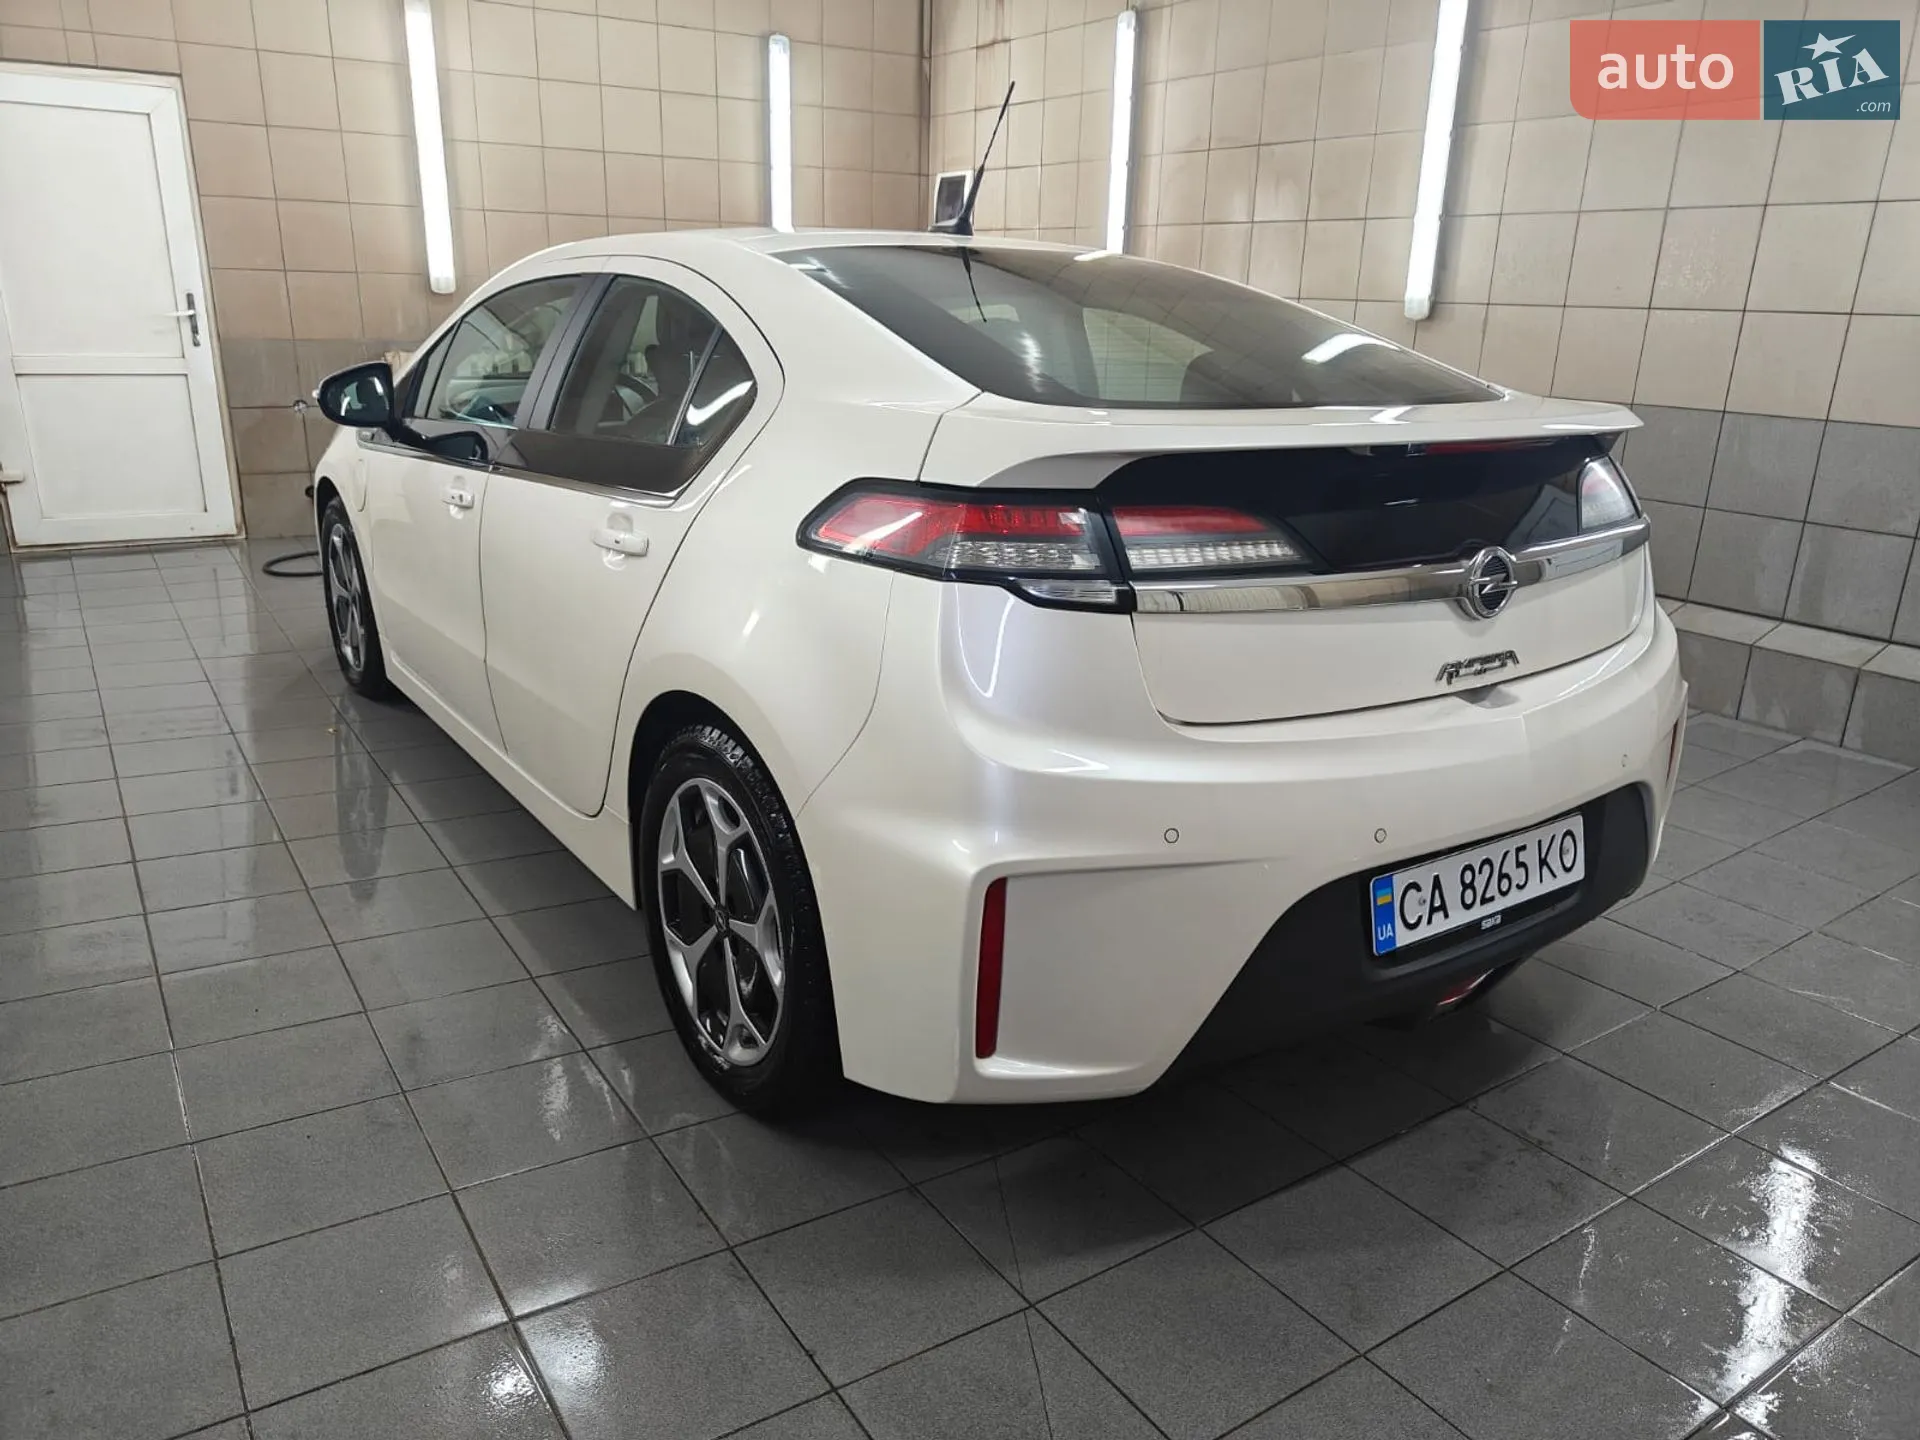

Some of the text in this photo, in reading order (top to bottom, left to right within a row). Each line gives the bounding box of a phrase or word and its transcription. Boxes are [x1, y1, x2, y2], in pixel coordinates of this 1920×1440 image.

[1399, 829, 1578, 930] CA 8265 KO
[1377, 922, 1394, 942] UA
